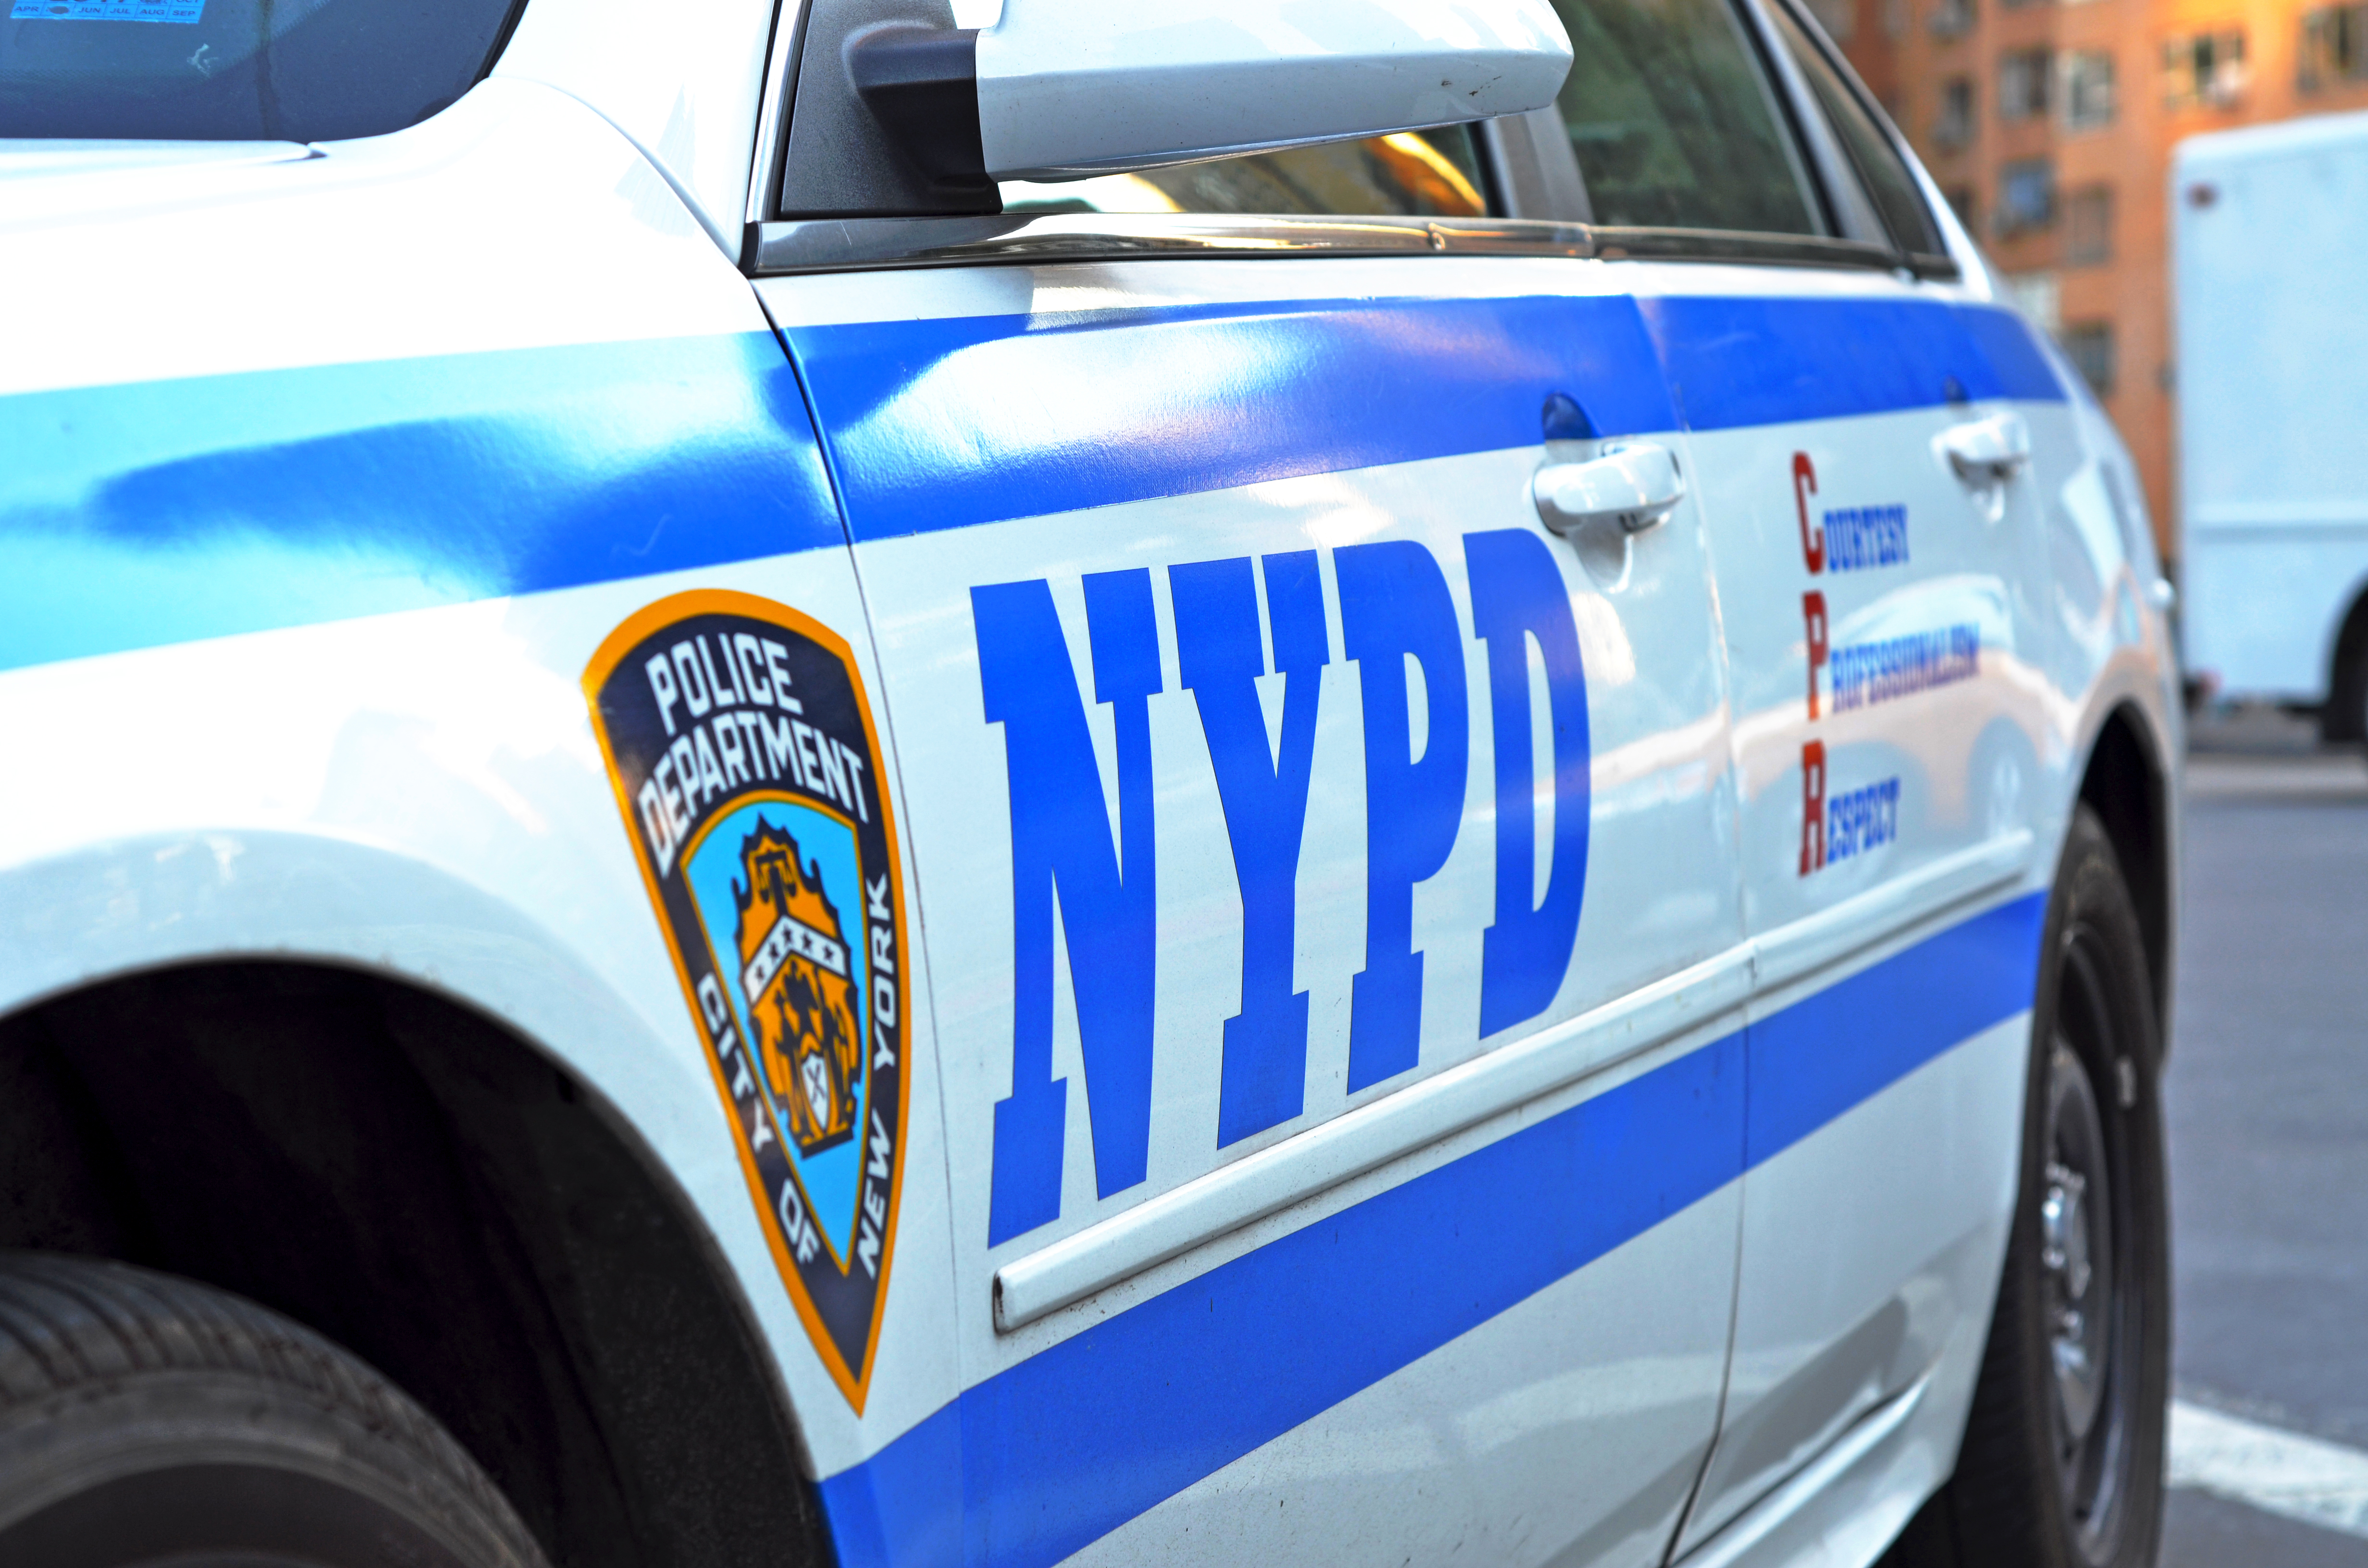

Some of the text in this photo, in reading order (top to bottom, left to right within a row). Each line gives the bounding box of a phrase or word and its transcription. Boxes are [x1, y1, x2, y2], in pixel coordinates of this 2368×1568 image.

[637, 710, 869, 880] DEPARTMENT
[644, 632, 803, 736] POLICE
[969, 527, 1591, 1250] NYPD
[697, 972, 821, 1264] CITY OF
[857, 871, 897, 1281] NEW YORK
